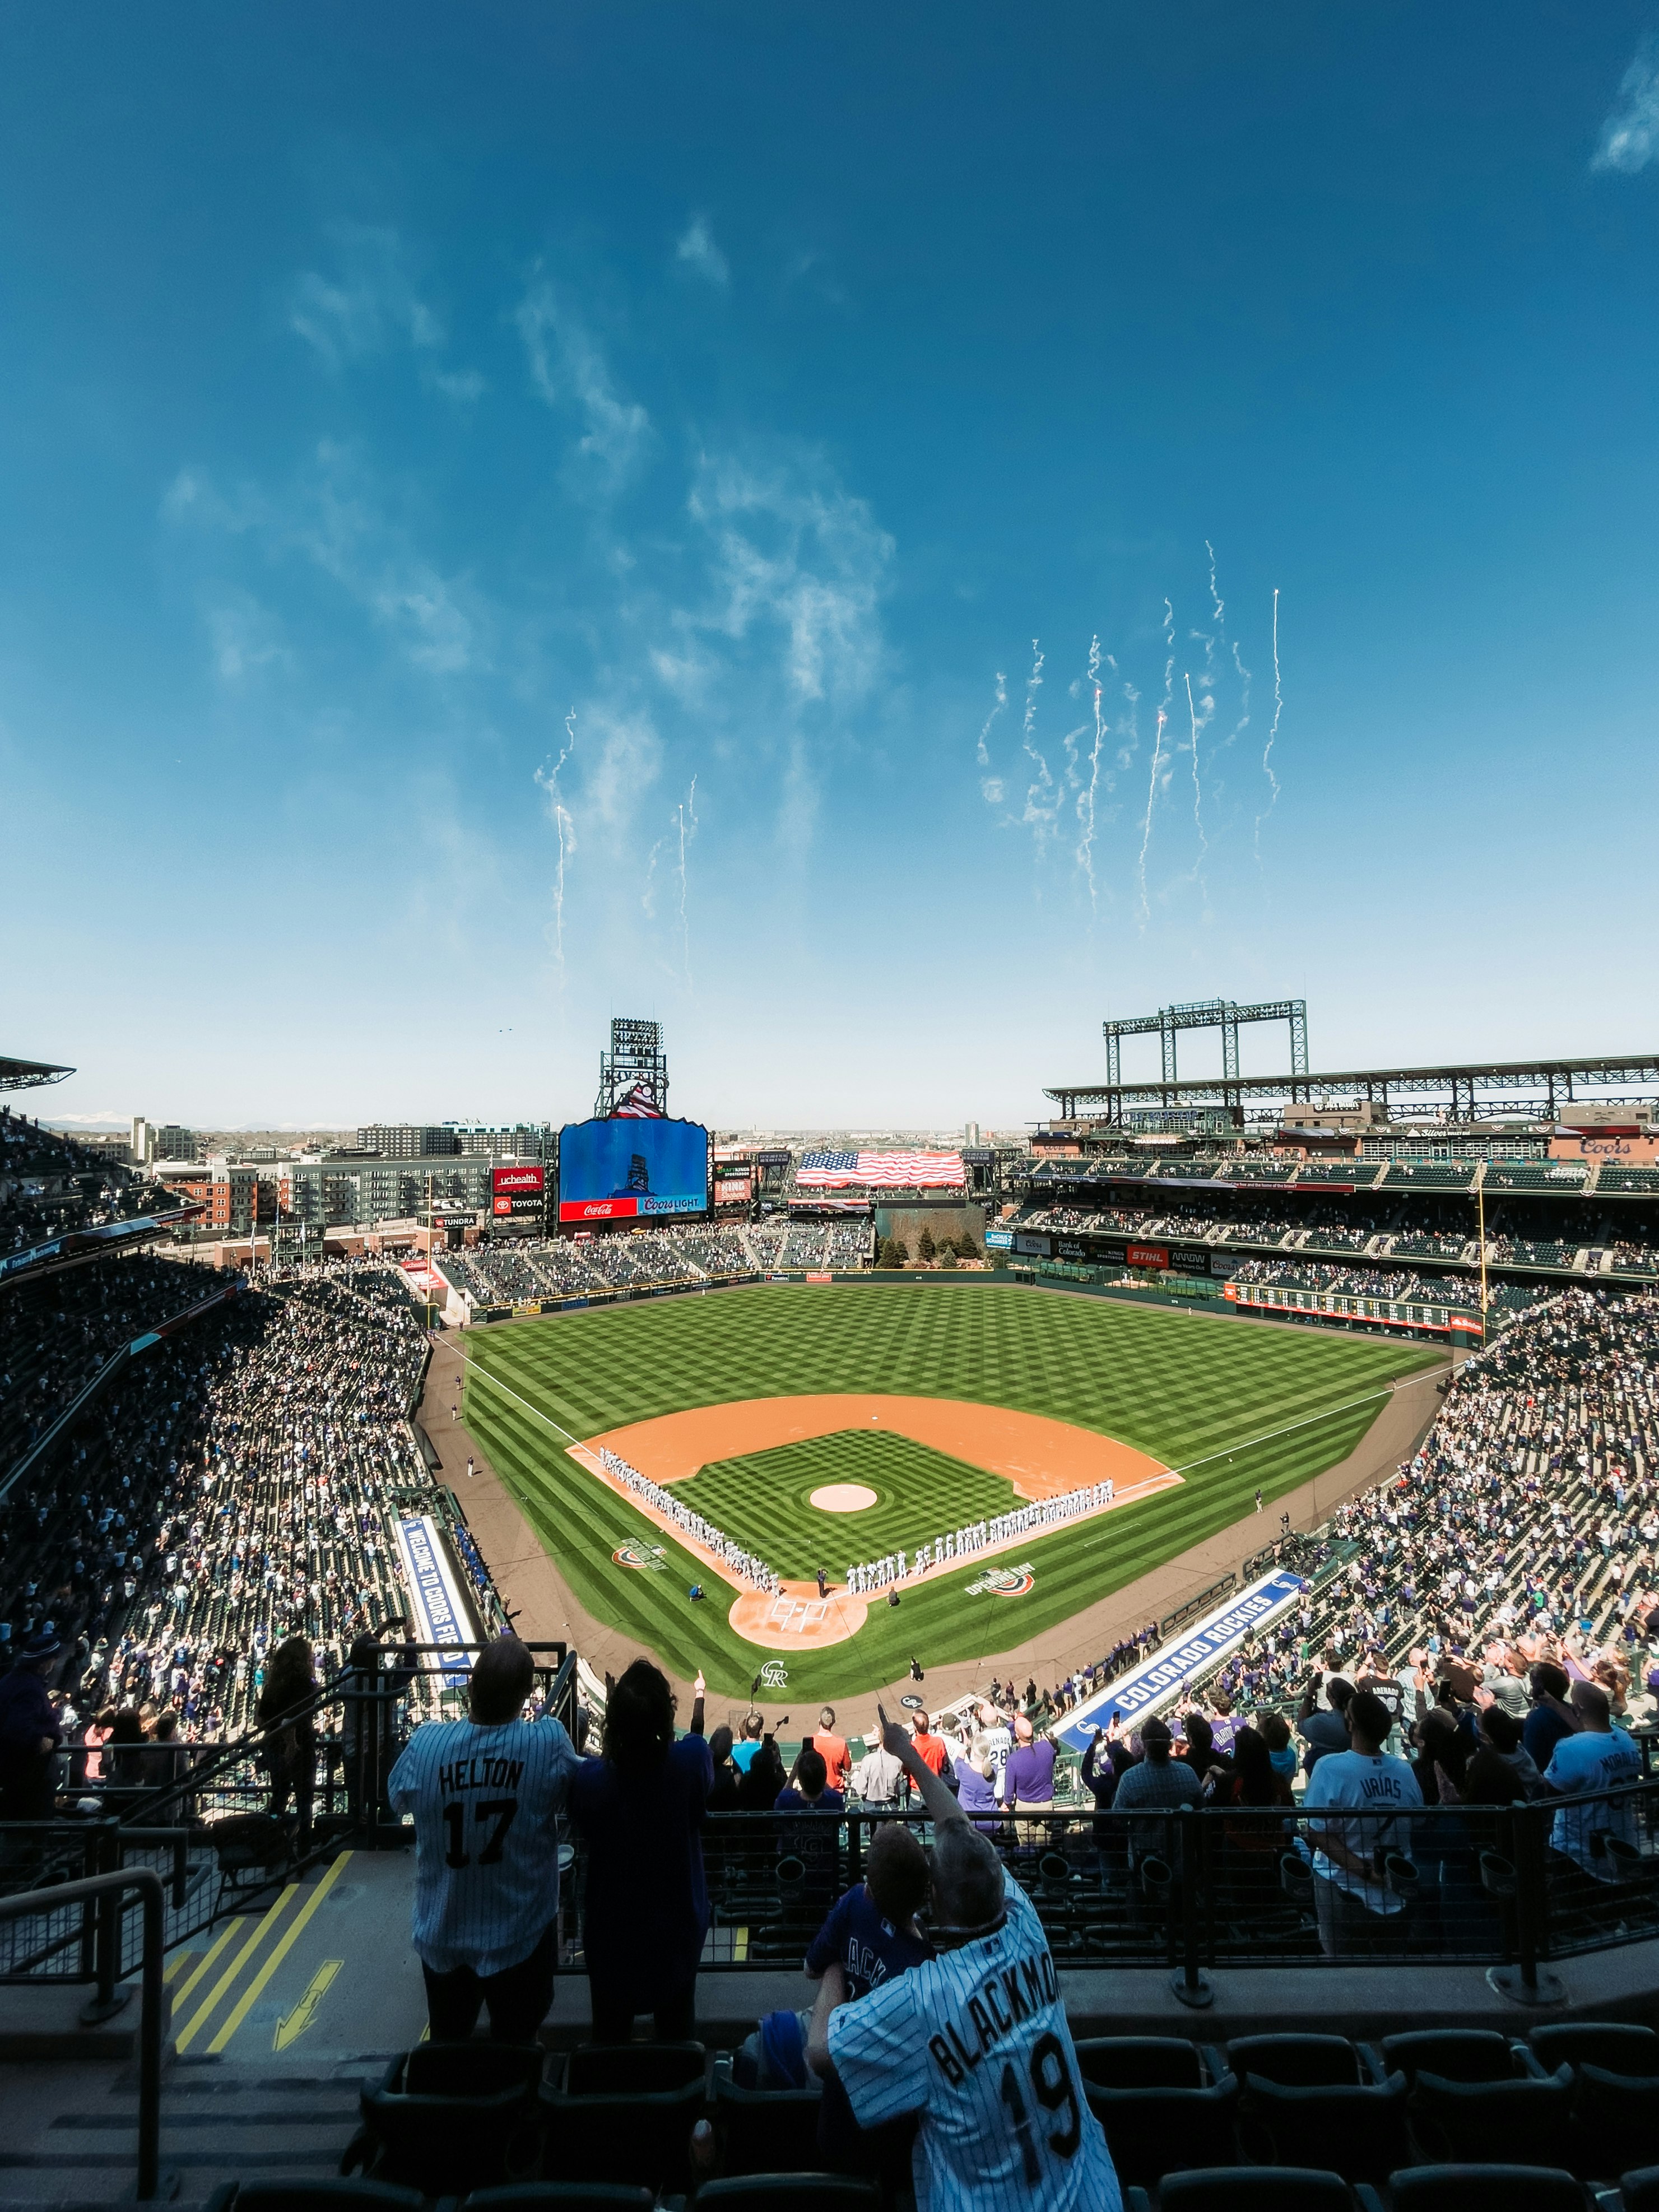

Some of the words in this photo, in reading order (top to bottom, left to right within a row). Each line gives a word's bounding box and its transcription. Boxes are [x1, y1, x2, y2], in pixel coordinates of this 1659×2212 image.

[1421, 1128, 1447, 1137] Silver
[1579, 1140, 1632, 1154] Coors
[501, 1173, 537, 1184] uchealth
[722, 1181, 745, 1192] KING
[644, 1198, 672, 1210] Coors
[675, 1198, 699, 1207] LIGHT
[1025, 1239, 1042, 1248] Coors
[1059, 1248, 1085, 1257] Colorado
[1132, 1251, 1163, 1262] STIHL
[1212, 1261, 1238, 1271] Coors
[408, 1529, 435, 1574] WELCOME
[420, 1573, 439, 1587] TO
[964, 1572, 1016, 1596] OPENING
[1011, 1562, 1035, 1576] DAY
[424, 1586, 452, 1625] COORS
[435, 1624, 464, 1662] FIED
[1115, 1641, 1212, 1711] COLORADO
[1204, 1595, 1273, 1643] ROCKIES
[989, 1737, 1011, 1746] RENADO
[990, 1749, 1007, 1766] 28
[439, 1758, 525, 1795] HELTON
[443, 1797, 519, 1869] 17
[928, 1951, 1062, 2086] BLACKMO
[1000, 2031, 1080, 2183] 19
